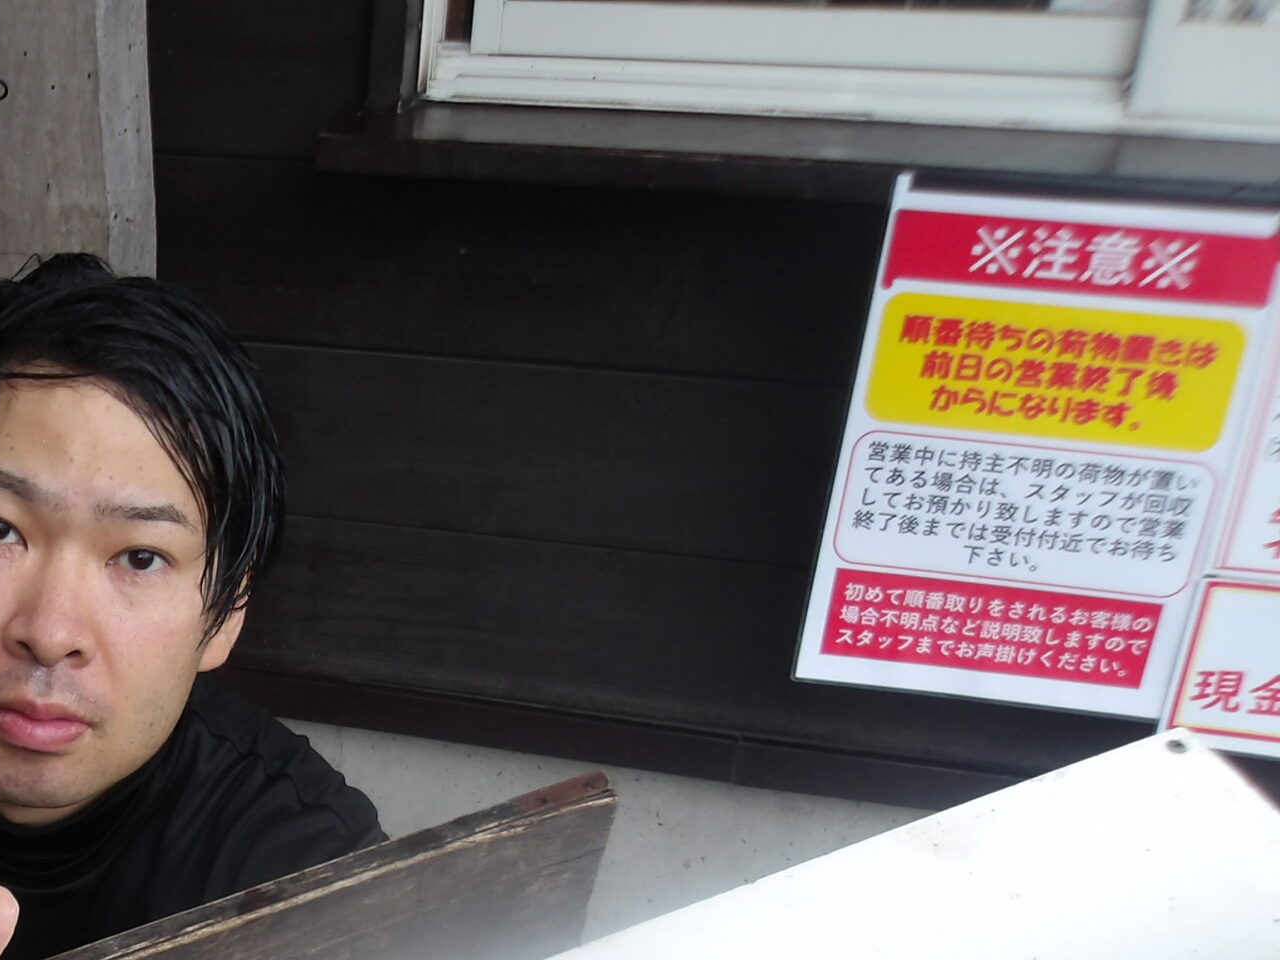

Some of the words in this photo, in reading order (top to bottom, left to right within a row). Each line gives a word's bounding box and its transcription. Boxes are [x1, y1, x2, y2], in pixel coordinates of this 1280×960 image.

[969, 224, 1201, 291] ※注意※
[919, 350, 1180, 401] 前日の営業終了後
[928, 385, 1143, 432] からになります。
[863, 465, 1194, 516] てある場合は、スタッフが回収
[866, 440, 1199, 492] 営業中に持主不明の荷物が置い
[851, 509, 1176, 564] 終了後までは受付付近でお待ち
[859, 489, 1184, 540] してお預かり致しますので営業
[966, 543, 1041, 573] 下さい。
[839, 604, 1147, 656] 場合不明点など説明致しますので
[844, 580, 1153, 635] 初めて順番取りをされるお客様の
[835, 628, 1130, 678] スタッフまでお声掛けください。
